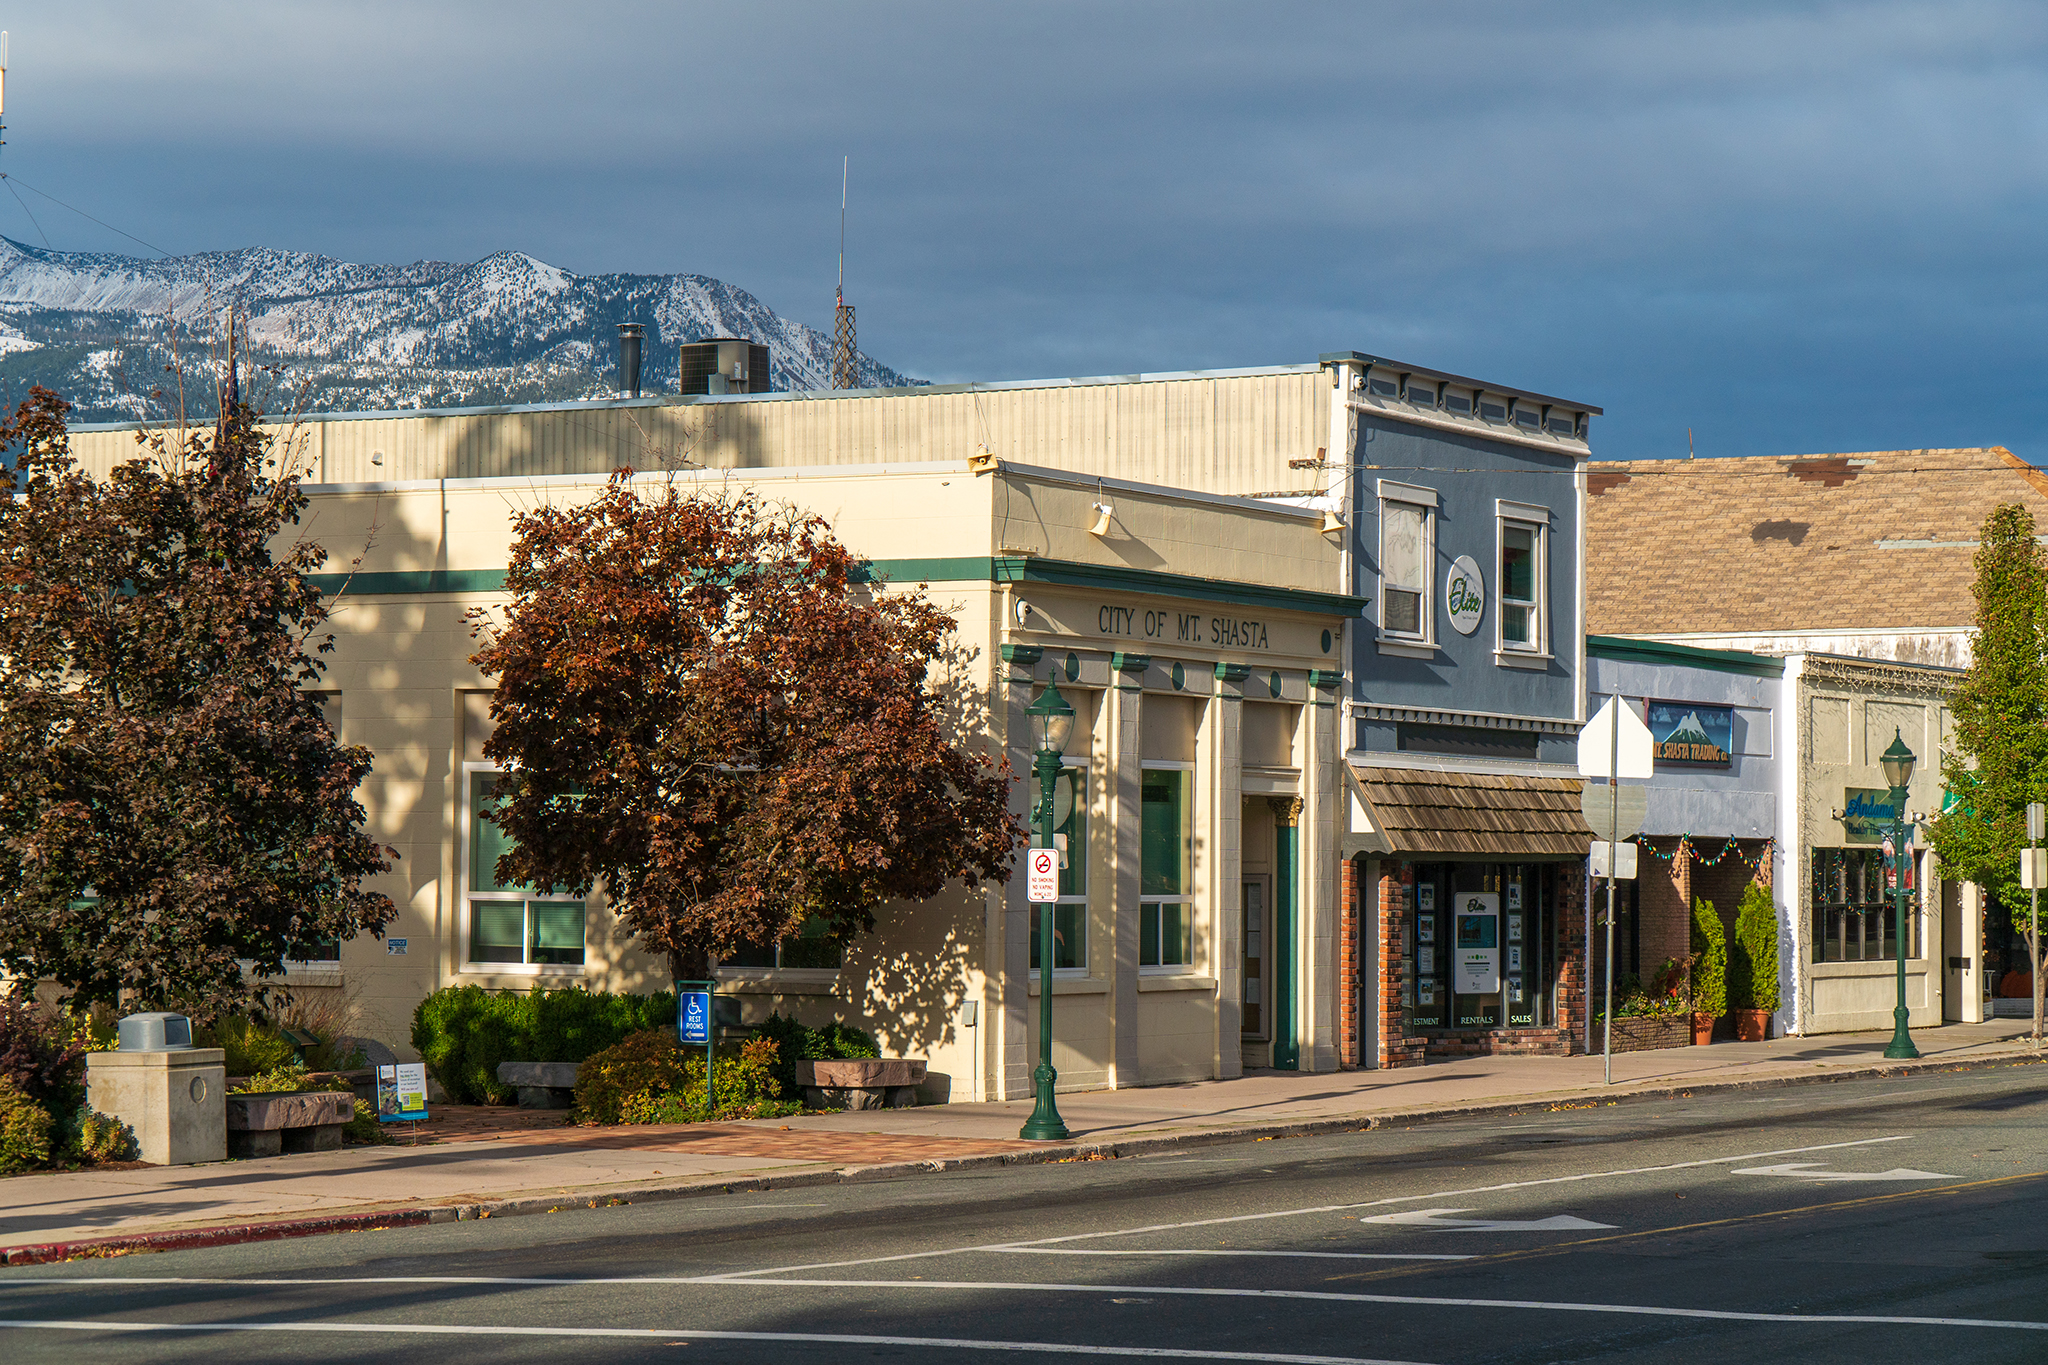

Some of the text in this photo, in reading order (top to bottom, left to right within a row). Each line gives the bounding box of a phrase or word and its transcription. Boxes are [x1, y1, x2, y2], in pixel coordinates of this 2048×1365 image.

[1449, 577, 1482, 615] Elite
[1099, 604, 1269, 649] CITY OF MT. SHASTA
[1663, 742, 1690, 760] SHASTA
[1691, 743, 1720, 761] TRADING
[1846, 792, 1895, 819] Andama
[1460, 1016, 1494, 1025] RENTALS
[1510, 1015, 1532, 1023] SALES
